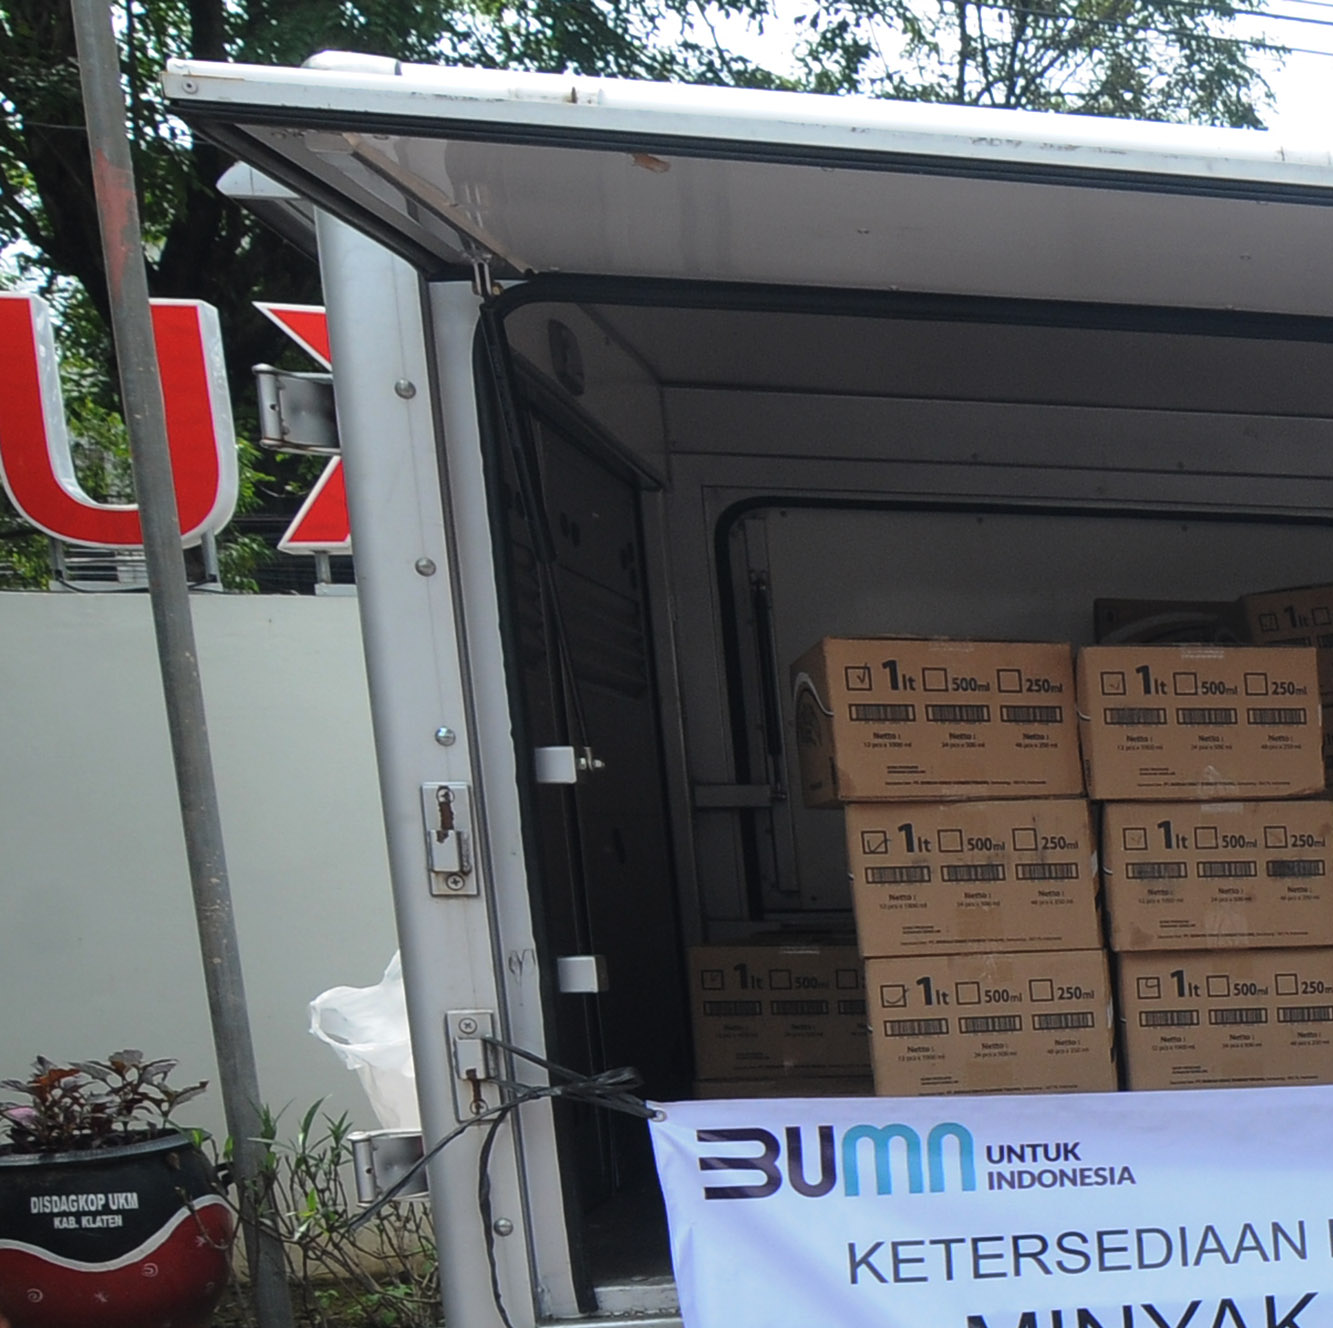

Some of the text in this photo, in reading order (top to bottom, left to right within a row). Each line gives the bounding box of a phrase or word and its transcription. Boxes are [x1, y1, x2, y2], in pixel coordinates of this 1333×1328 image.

[882, 659, 1063, 693] 1lt 500ml 250ml
[1136, 665, 1307, 695] 1lt 500ml 250ml
[898, 822, 1079, 853] 1lt 500ml 250ml
[1157, 820, 1326, 849] 1lt 500ml 250ml
[734, 963, 829, 989] 1lt 500ml
[1170, 969, 1200, 998] 1lt
[1233, 983, 1269, 996] 500ml
[916, 976, 1095, 1006] 1lt 500ml 250ml
[698, 1122, 977, 1200] BUMN
[986, 1141, 1081, 1165] UNTUK
[986, 1166, 1137, 1191] INDONESIA
[30, 1191, 139, 1214] DISDAGKOP UKM
[53, 1215, 123, 1229] KAB. KLATEN
[847, 1220, 1309, 1286] KETERSEDIAAN
